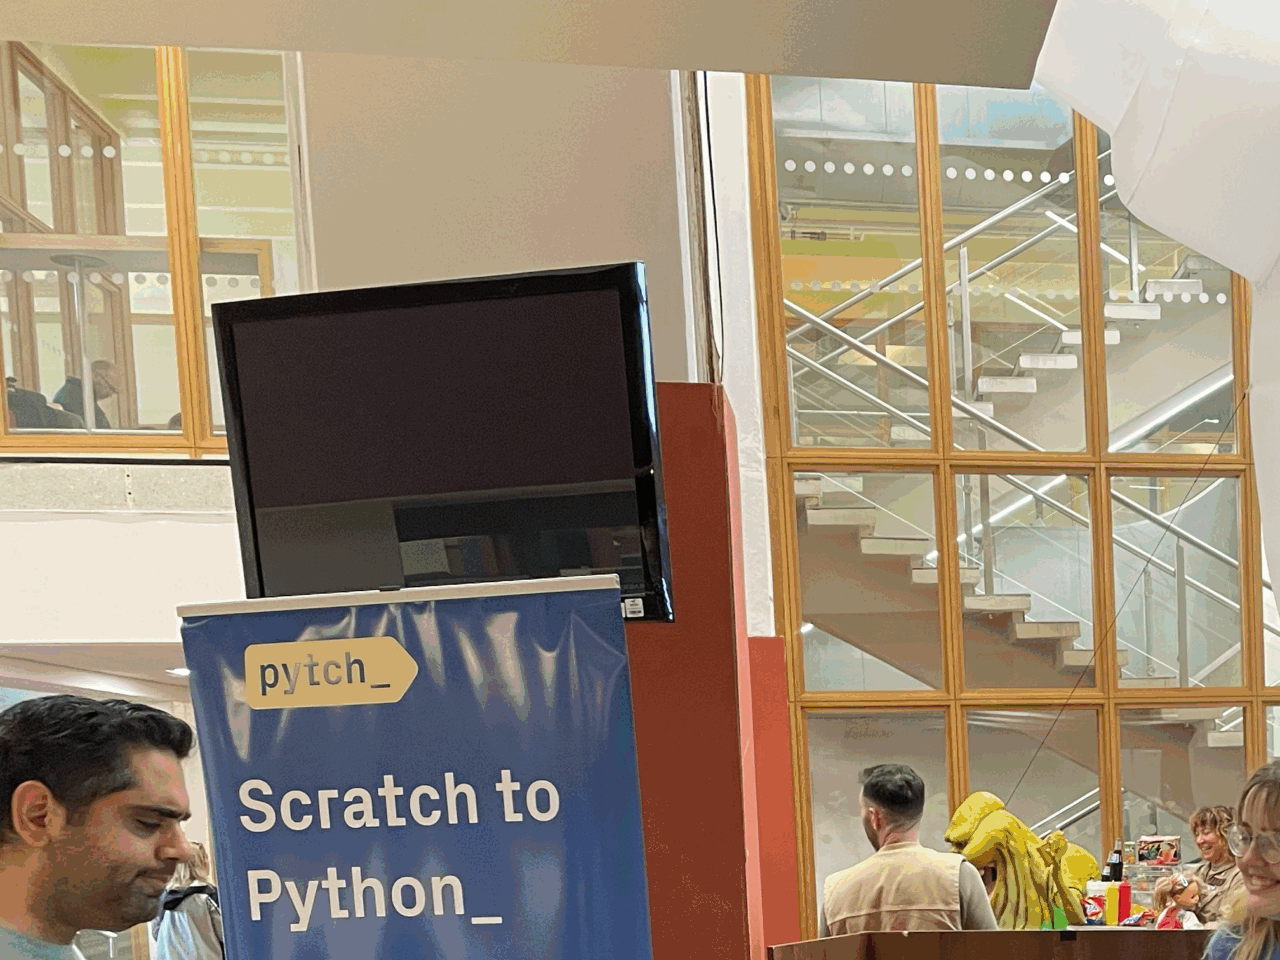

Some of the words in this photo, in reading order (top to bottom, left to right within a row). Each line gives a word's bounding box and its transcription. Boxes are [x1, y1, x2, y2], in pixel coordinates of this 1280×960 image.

[259, 652, 391, 695] pytch_
[238, 771, 480, 832] Scratch
[495, 769, 561, 823] to
[246, 866, 503, 932] Python_
